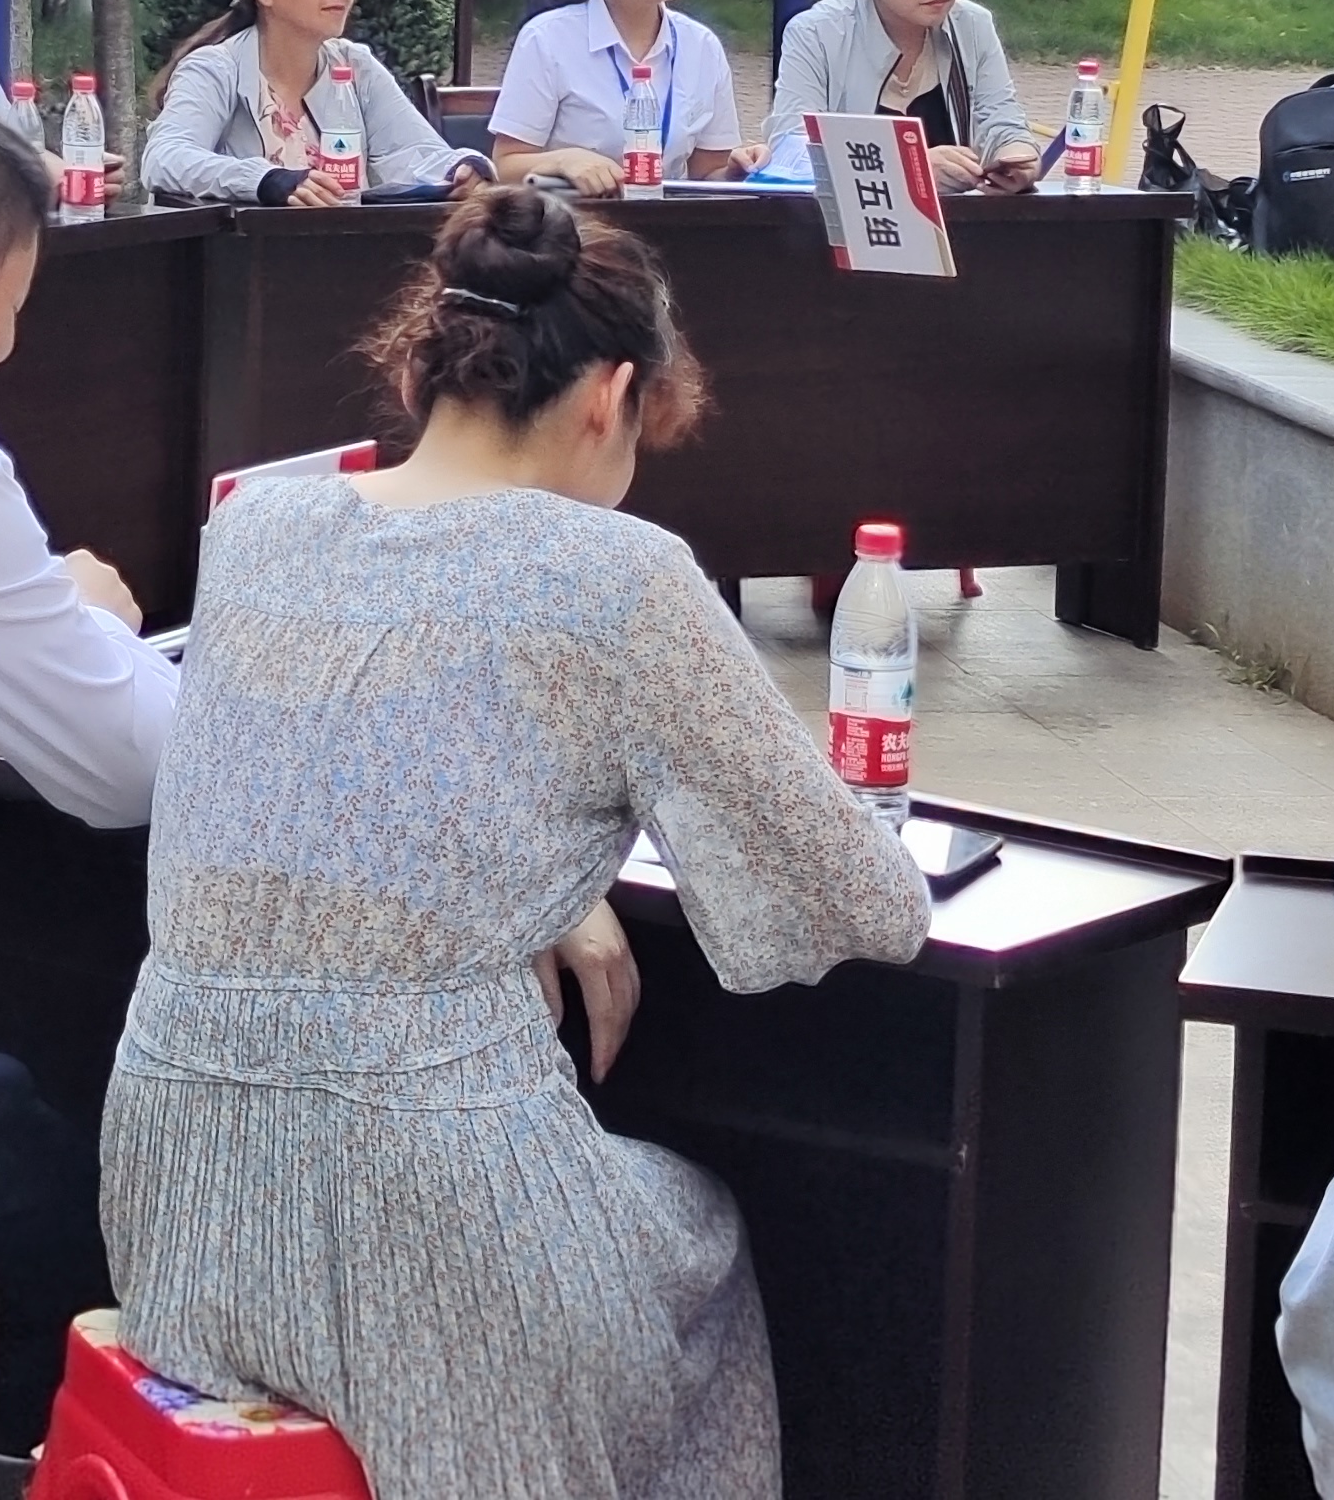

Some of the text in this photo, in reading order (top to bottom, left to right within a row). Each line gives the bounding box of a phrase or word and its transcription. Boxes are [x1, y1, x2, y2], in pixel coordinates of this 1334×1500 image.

[845, 140, 902, 248] 第五组
[881, 730, 910, 752] 农夫
